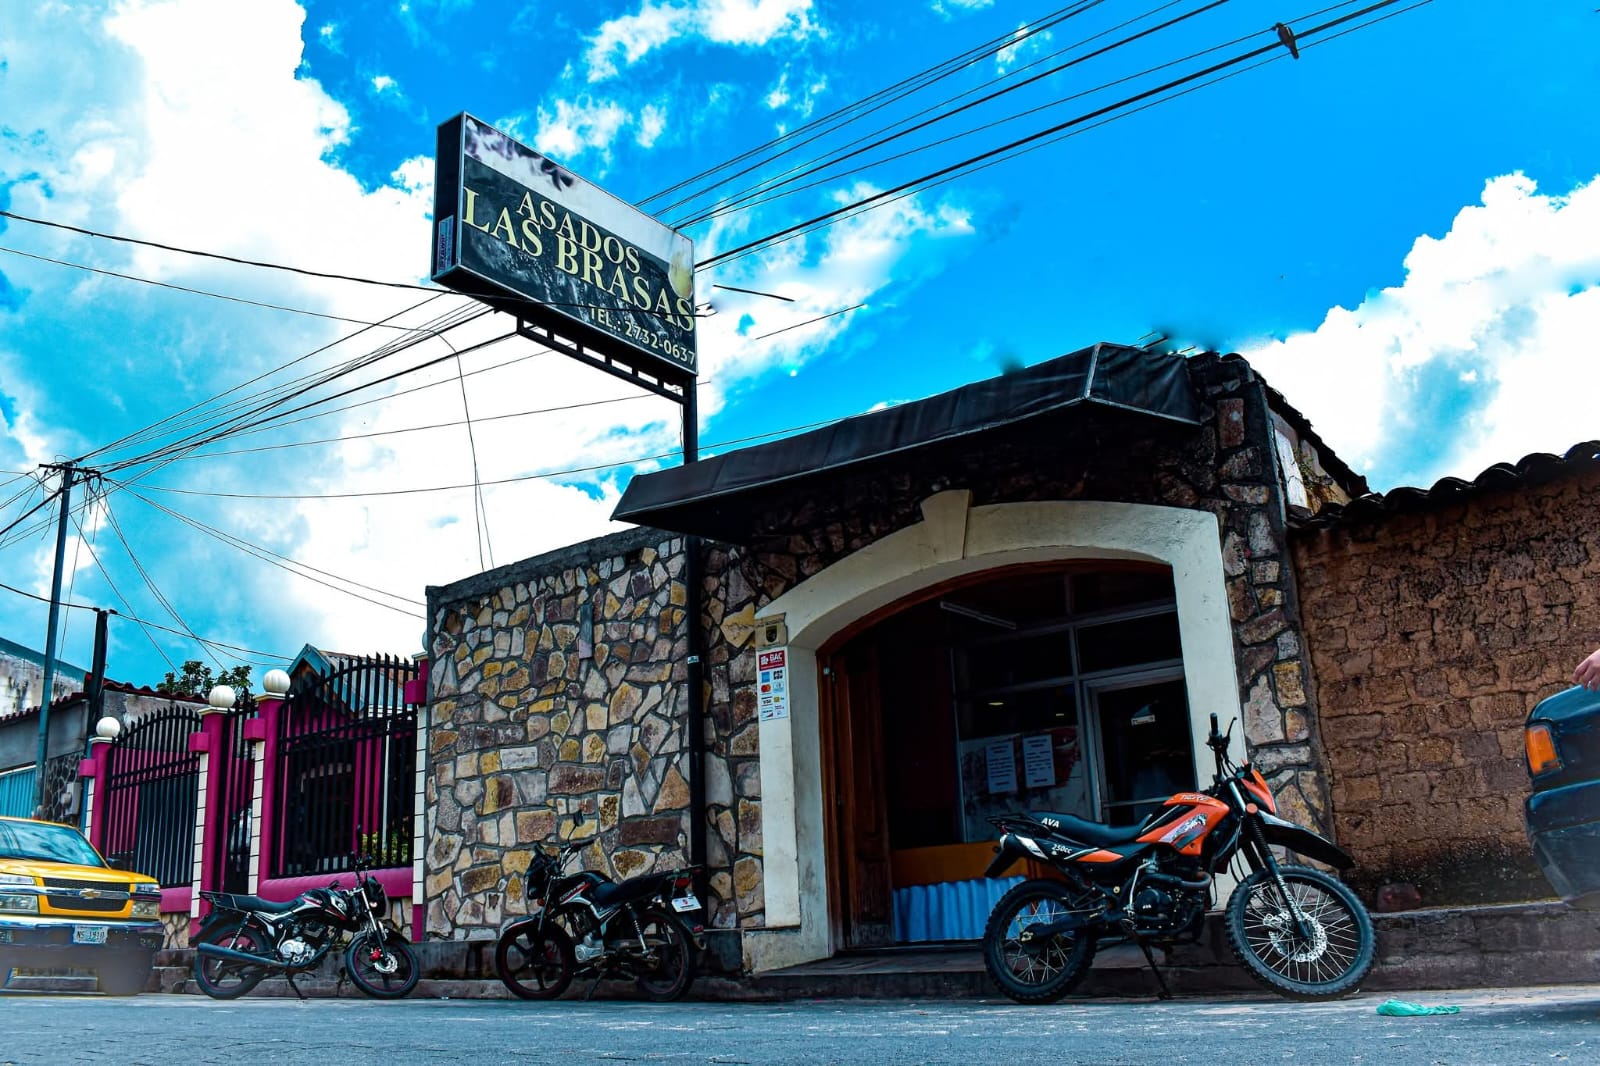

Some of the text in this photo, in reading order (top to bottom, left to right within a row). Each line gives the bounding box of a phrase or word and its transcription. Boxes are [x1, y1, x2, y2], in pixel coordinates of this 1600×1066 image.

[462, 186, 543, 257] LAS
[555, 232, 695, 332] BRASAS
[515, 190, 641, 275] ASADOS
[624, 320, 696, 366] 2732-0637
[1041, 817, 1060, 828] AVA
